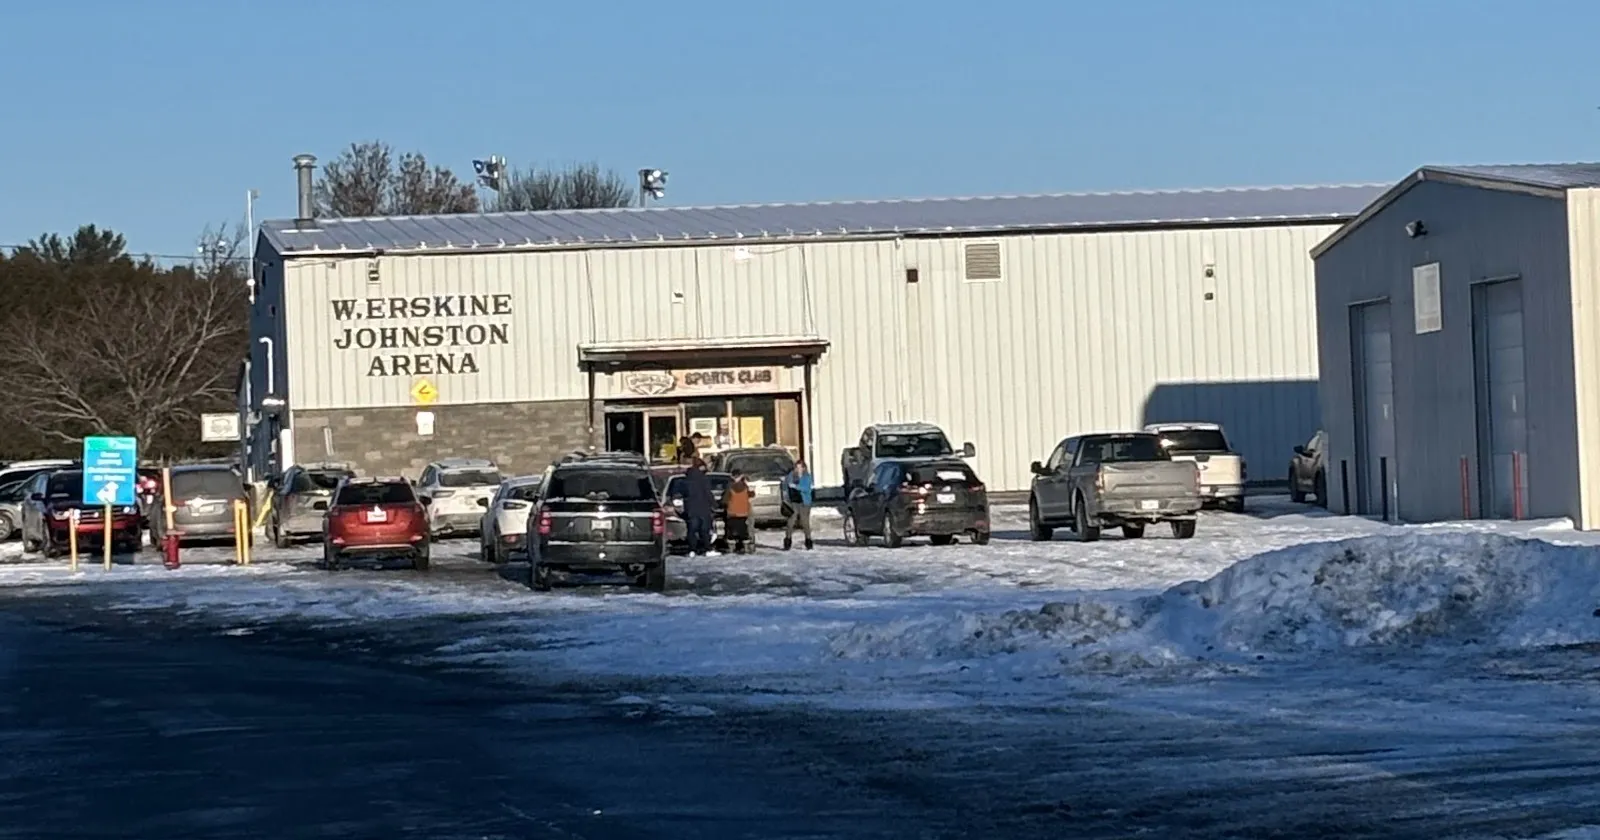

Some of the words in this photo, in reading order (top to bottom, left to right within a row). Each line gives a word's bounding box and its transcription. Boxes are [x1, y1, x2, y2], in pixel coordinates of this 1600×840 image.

[333, 323, 508, 349] JOHNSTON
[366, 353, 480, 377] ARENA
[684, 370, 736, 386] SPORTS
[737, 369, 773, 384] CLUB
